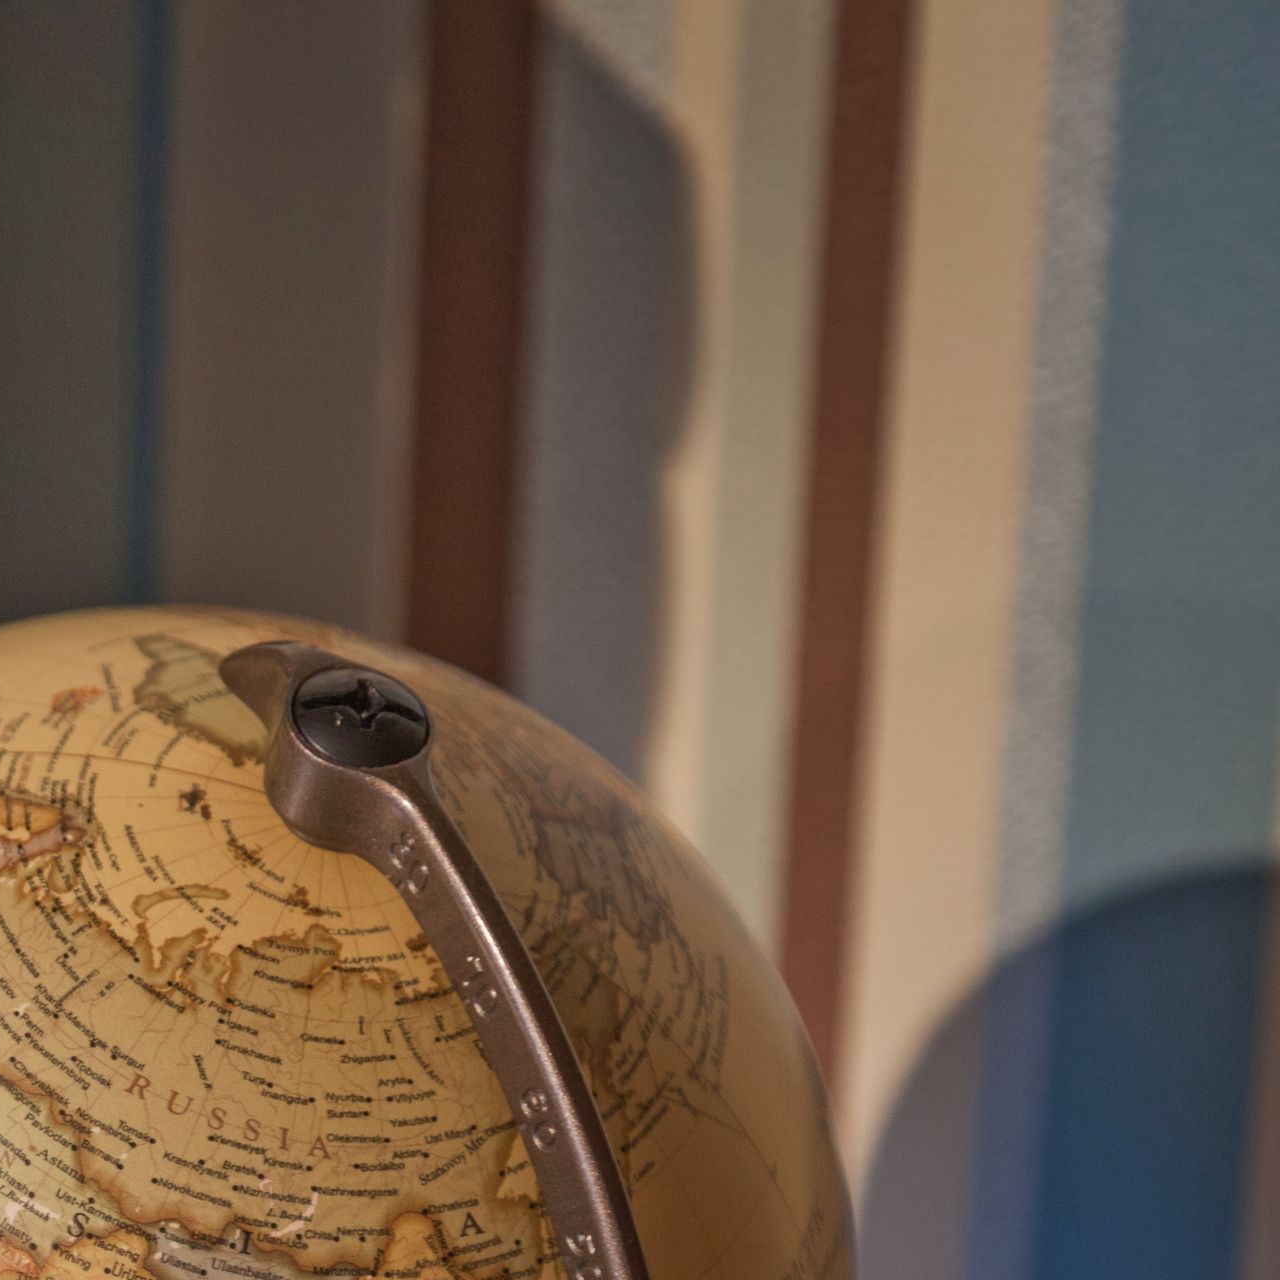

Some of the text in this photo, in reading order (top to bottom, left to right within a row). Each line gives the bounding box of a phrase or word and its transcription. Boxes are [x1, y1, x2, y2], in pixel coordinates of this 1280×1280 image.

[134, 976, 186, 1013] Salekhard
[232, 998, 276, 1020] Dudinka
[20, 1013, 45, 1037] Perm
[225, 1019, 259, 1037] Igarka
[110, 1044, 145, 1071] Surgut
[220, 1039, 283, 1065] Turukhansk
[14, 1058, 71, 1109] Chelyabinsk
[73, 1057, 113, 1088] Tobolsk
[325, 1092, 365, 1103] Nyurba
[124, 1072, 331, 1158] RUSSIA
[326, 1109, 363, 1119] Suntar
[389, 1115, 432, 1128] Yakutsk
[75, 1108, 131, 1148] Novosibirsk
[117, 1120, 150, 1141] Tomsk
[39, 1149, 86, 1184] Astana
[222, 1160, 258, 1177] Bratsk
[360, 1162, 405, 1172] Bodaibo
[158, 1178, 233, 1208] Novokuznetsk
[57, 1247, 92, 1270] Yining
[92, 1235, 140, 1262] Tacheng
